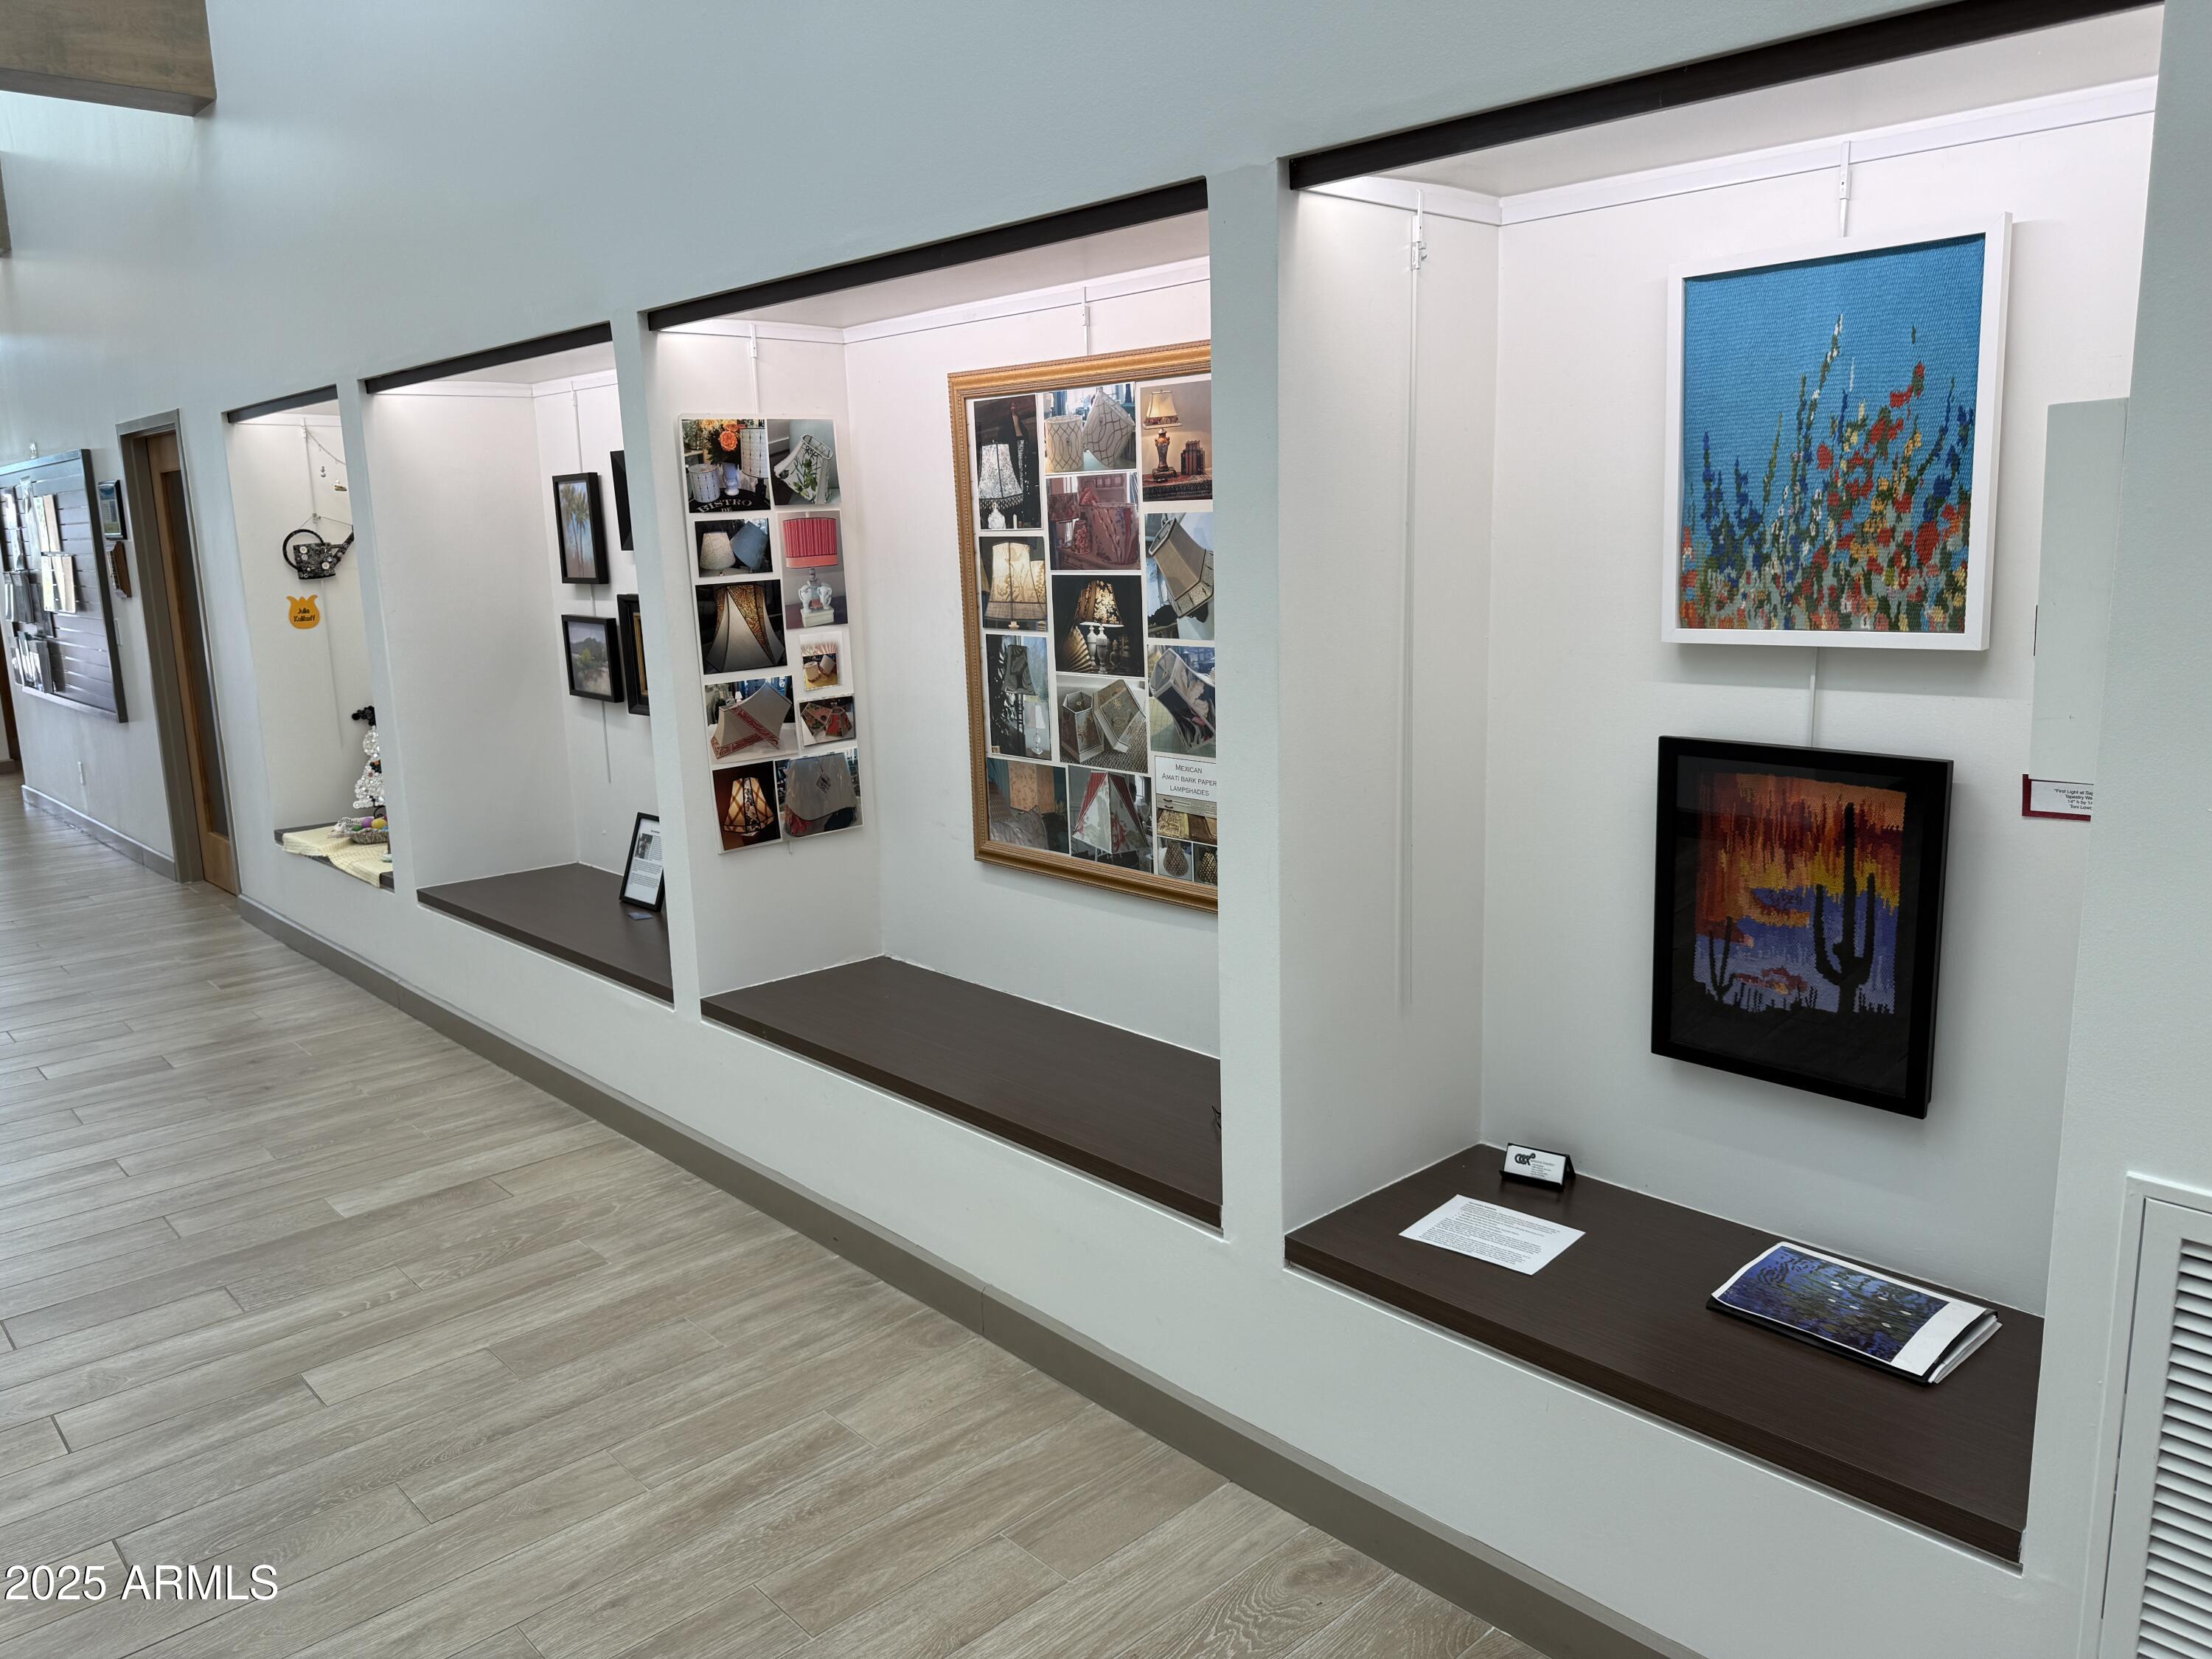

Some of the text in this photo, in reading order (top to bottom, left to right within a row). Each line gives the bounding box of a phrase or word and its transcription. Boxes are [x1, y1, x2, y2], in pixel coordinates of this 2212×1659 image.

[697, 499, 752, 512] BISTRO
[1175, 764, 1202, 773] MEXICAN
[1169, 785, 1209, 796] LAMPSHADES
